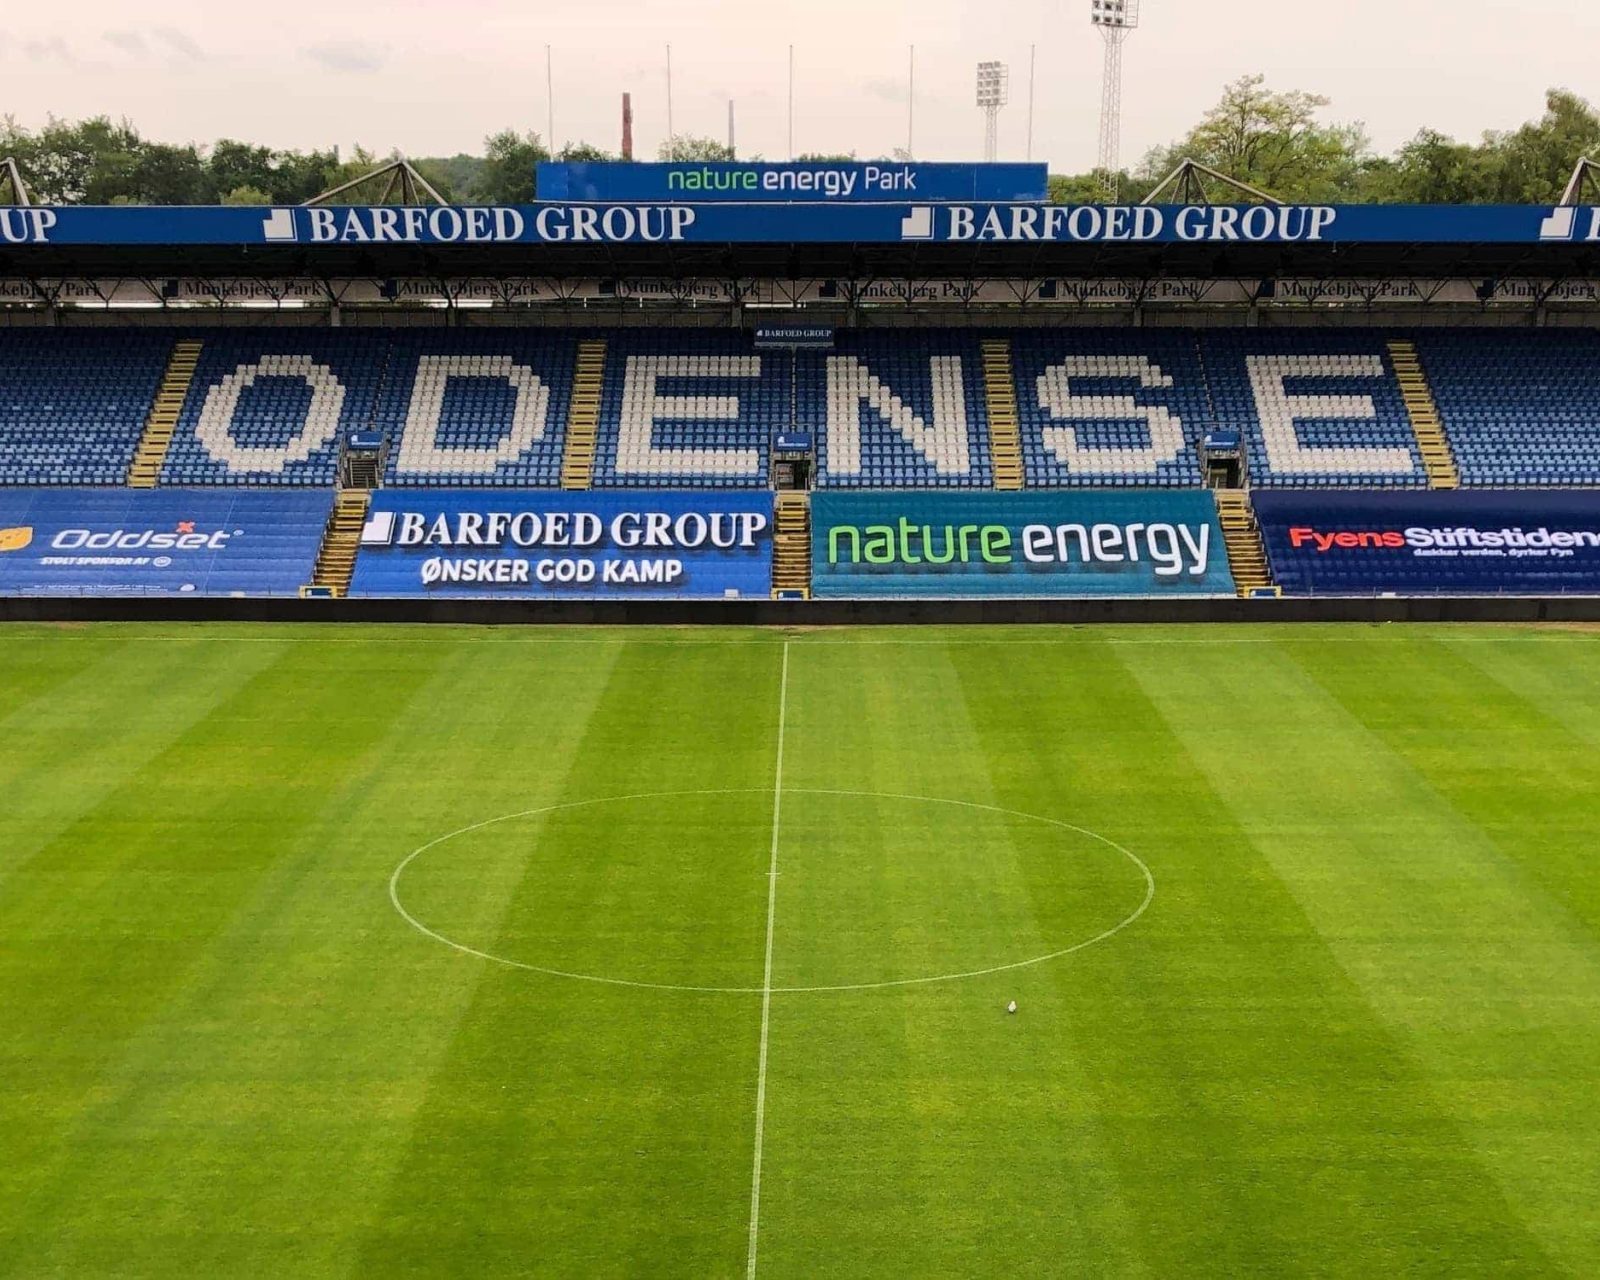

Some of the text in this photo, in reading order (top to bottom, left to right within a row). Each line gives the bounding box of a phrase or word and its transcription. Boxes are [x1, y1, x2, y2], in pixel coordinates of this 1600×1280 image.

[669, 167, 917, 196] nature energy Park
[0, 208, 57, 243] UP
[308, 206, 696, 242] BARFOED GROUP
[948, 206, 1336, 241] BARFOED GROUP
[65, 282, 101, 297] Park
[284, 282, 321, 296] Park
[403, 281, 540, 299] Munebjerg Park
[724, 281, 760, 297] Prk
[1163, 281, 1198, 296] Park
[1381, 282, 1417, 296] Park
[1501, 281, 1596, 298] Munkbjerg
[764, 329, 832, 337] BARFOED GROUP
[51, 529, 231, 549] Oddset
[399, 512, 767, 547] BARFOED GROUP
[1404, 527, 1600, 548] Stiftstiden
[829, 516, 1211, 577] nature energy
[420, 557, 682, 585] ØNSKER GOD KAMP
